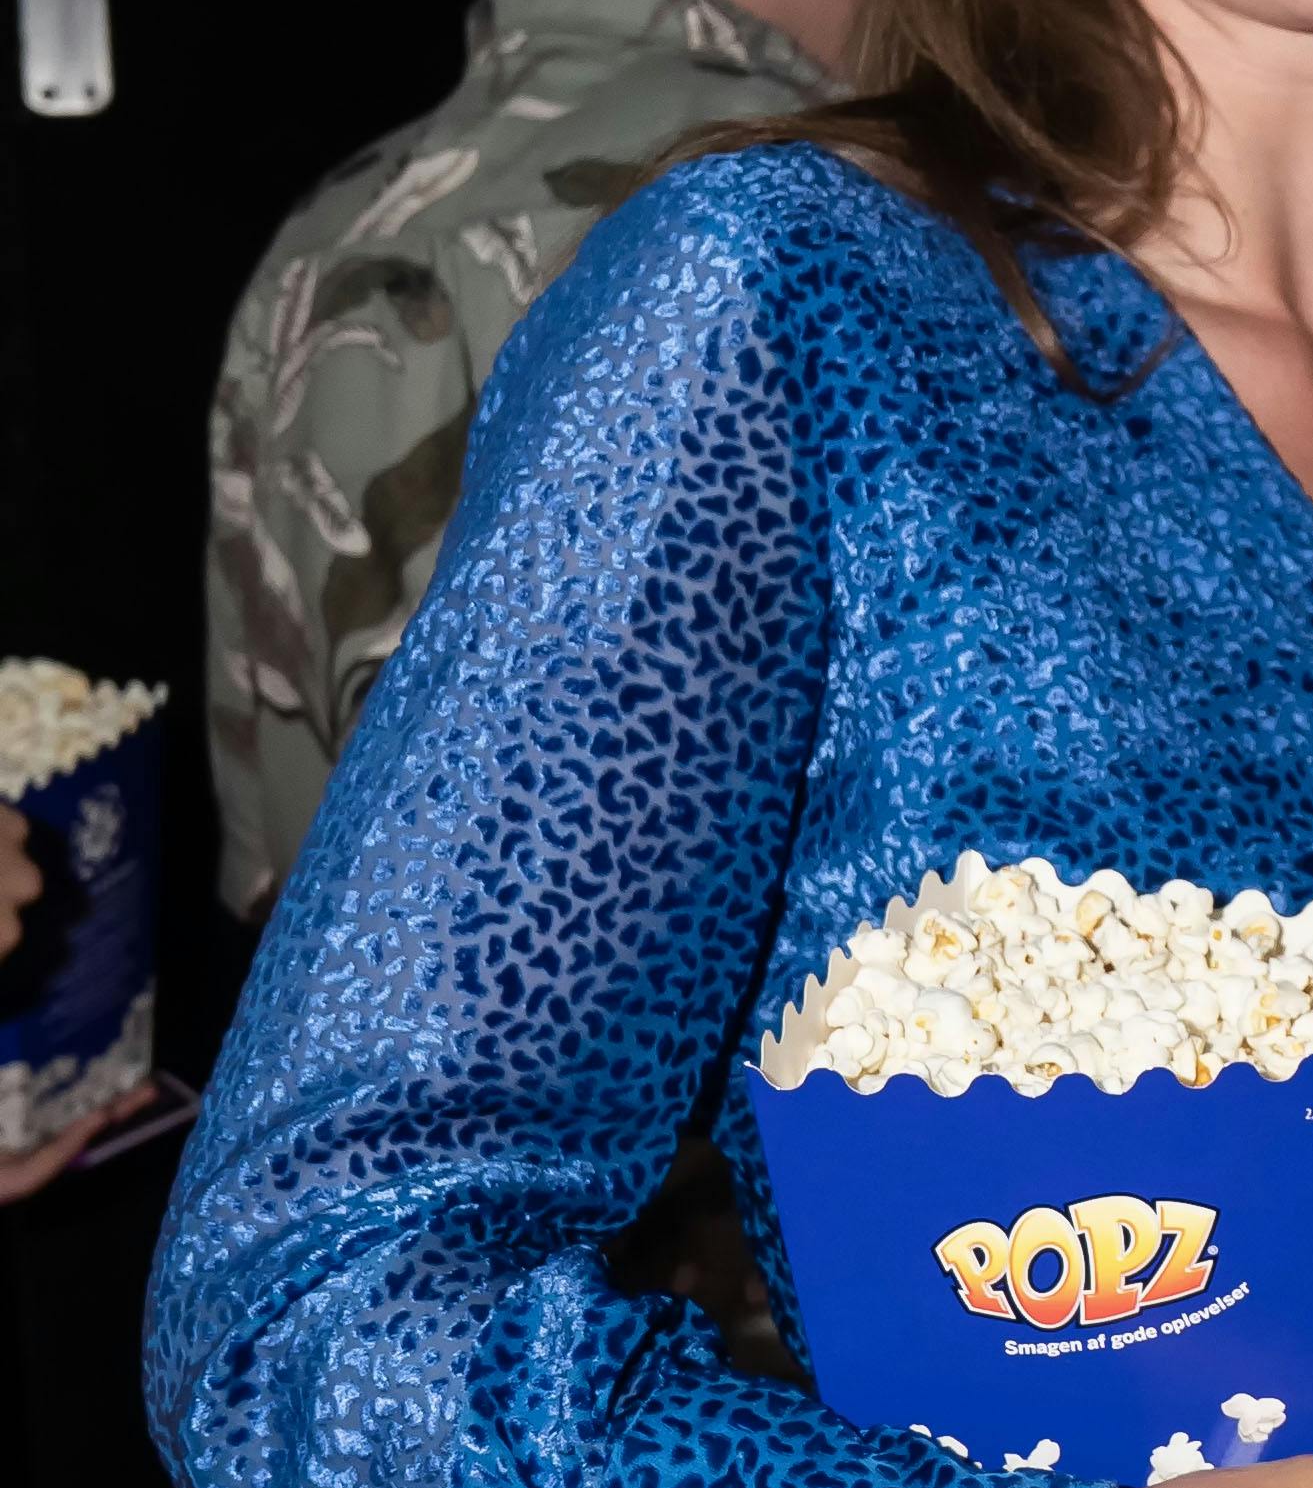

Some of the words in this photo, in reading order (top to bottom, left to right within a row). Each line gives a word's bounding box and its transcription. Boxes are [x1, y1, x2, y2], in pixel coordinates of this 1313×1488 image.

[934, 1195, 1217, 1329] POPZ
[1005, 1340, 1082, 1358] Smagen
[1087, 1334, 1106, 1350] af
[1111, 1325, 1157, 1350] gode
[1161, 1281, 1250, 1334] oplevelser
